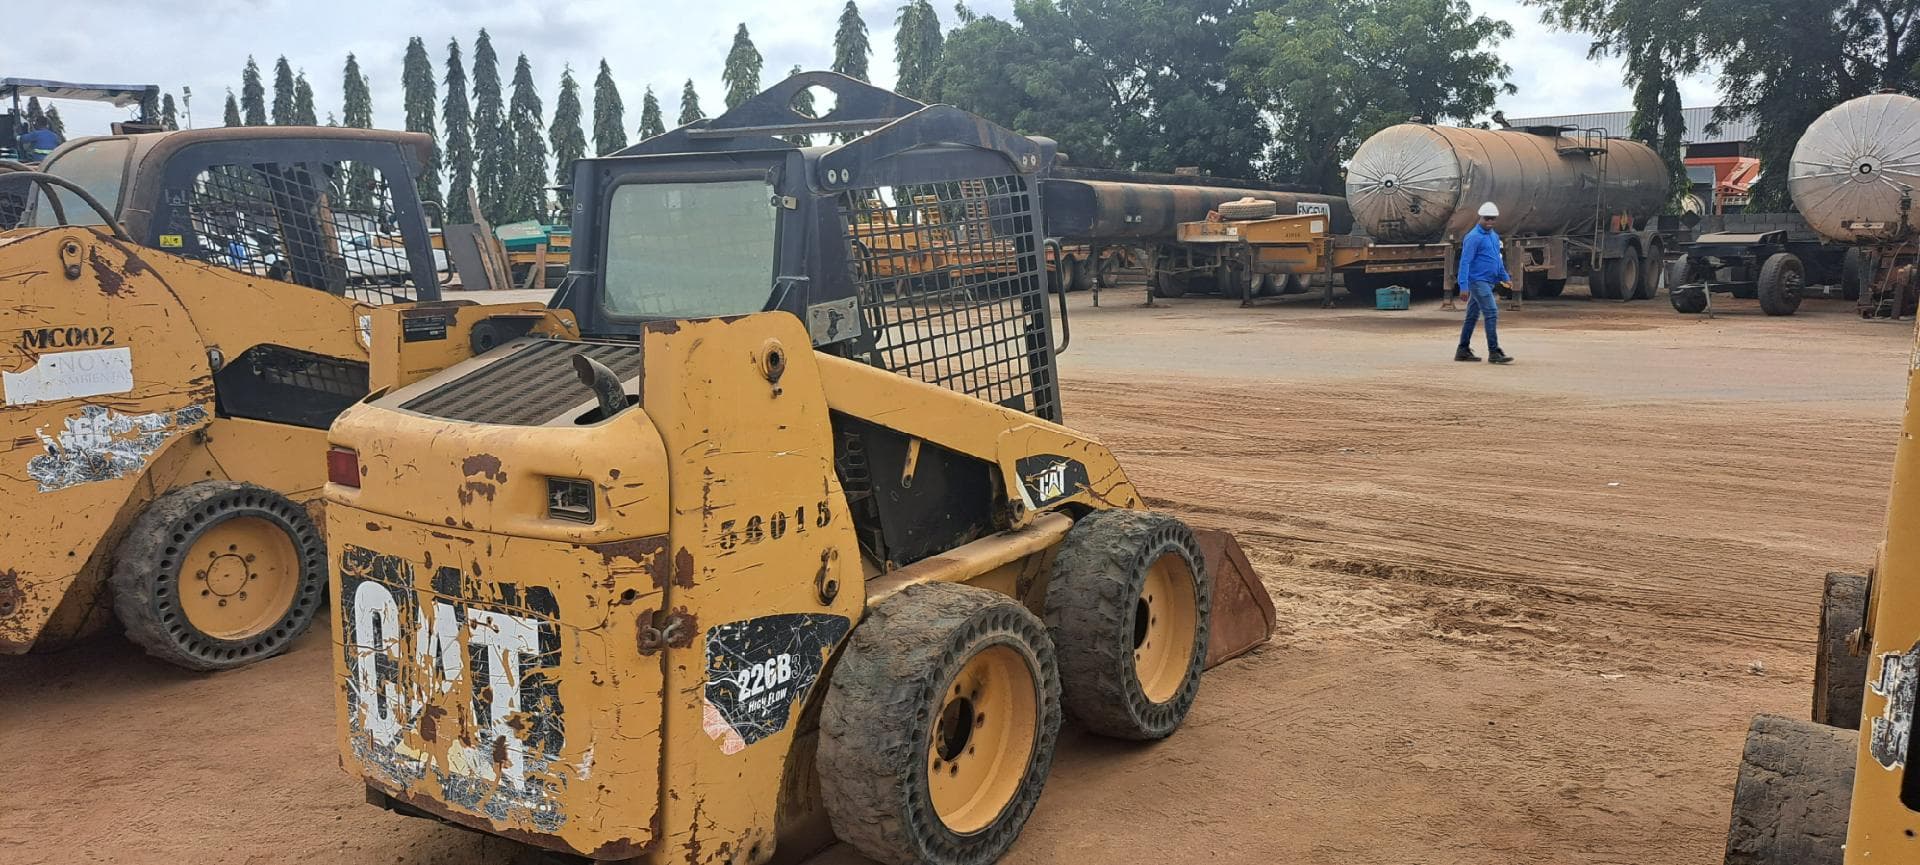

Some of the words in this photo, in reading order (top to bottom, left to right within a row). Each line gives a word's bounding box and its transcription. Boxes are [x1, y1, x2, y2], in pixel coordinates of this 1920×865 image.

[22, 327, 115, 348] MC002
[1040, 463, 1067, 502] CAT
[354, 580, 540, 792] CAT
[768, 687, 788, 706] FLOW
